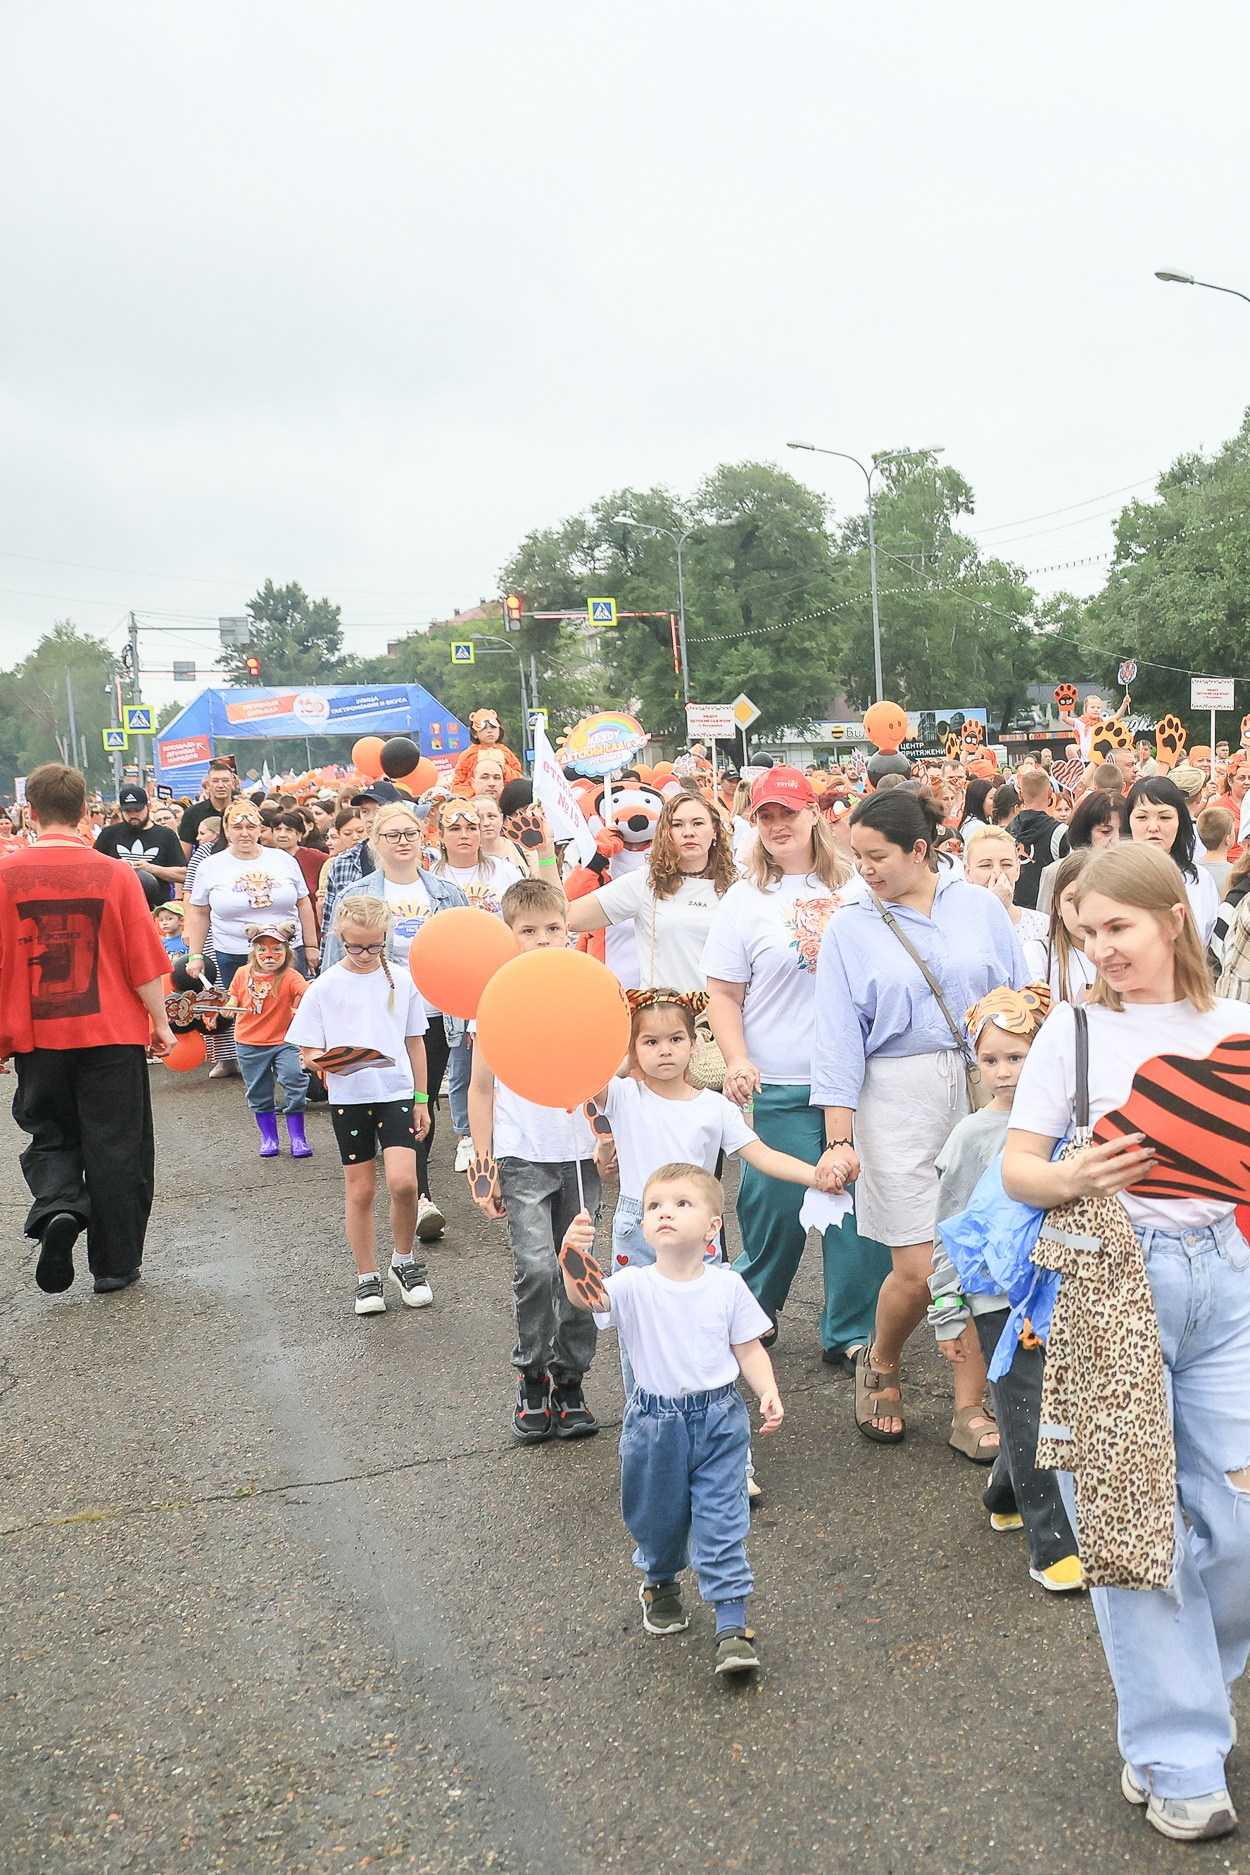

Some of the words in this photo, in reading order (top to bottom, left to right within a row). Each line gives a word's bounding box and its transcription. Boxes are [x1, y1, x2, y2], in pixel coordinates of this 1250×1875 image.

[604, 741, 626, 754] САД
[900, 742, 925, 751] ЦЕНТР
[901, 748, 947, 757] ПРИТЯЖЕНИ
[688, 900, 708, 908] ZARA
